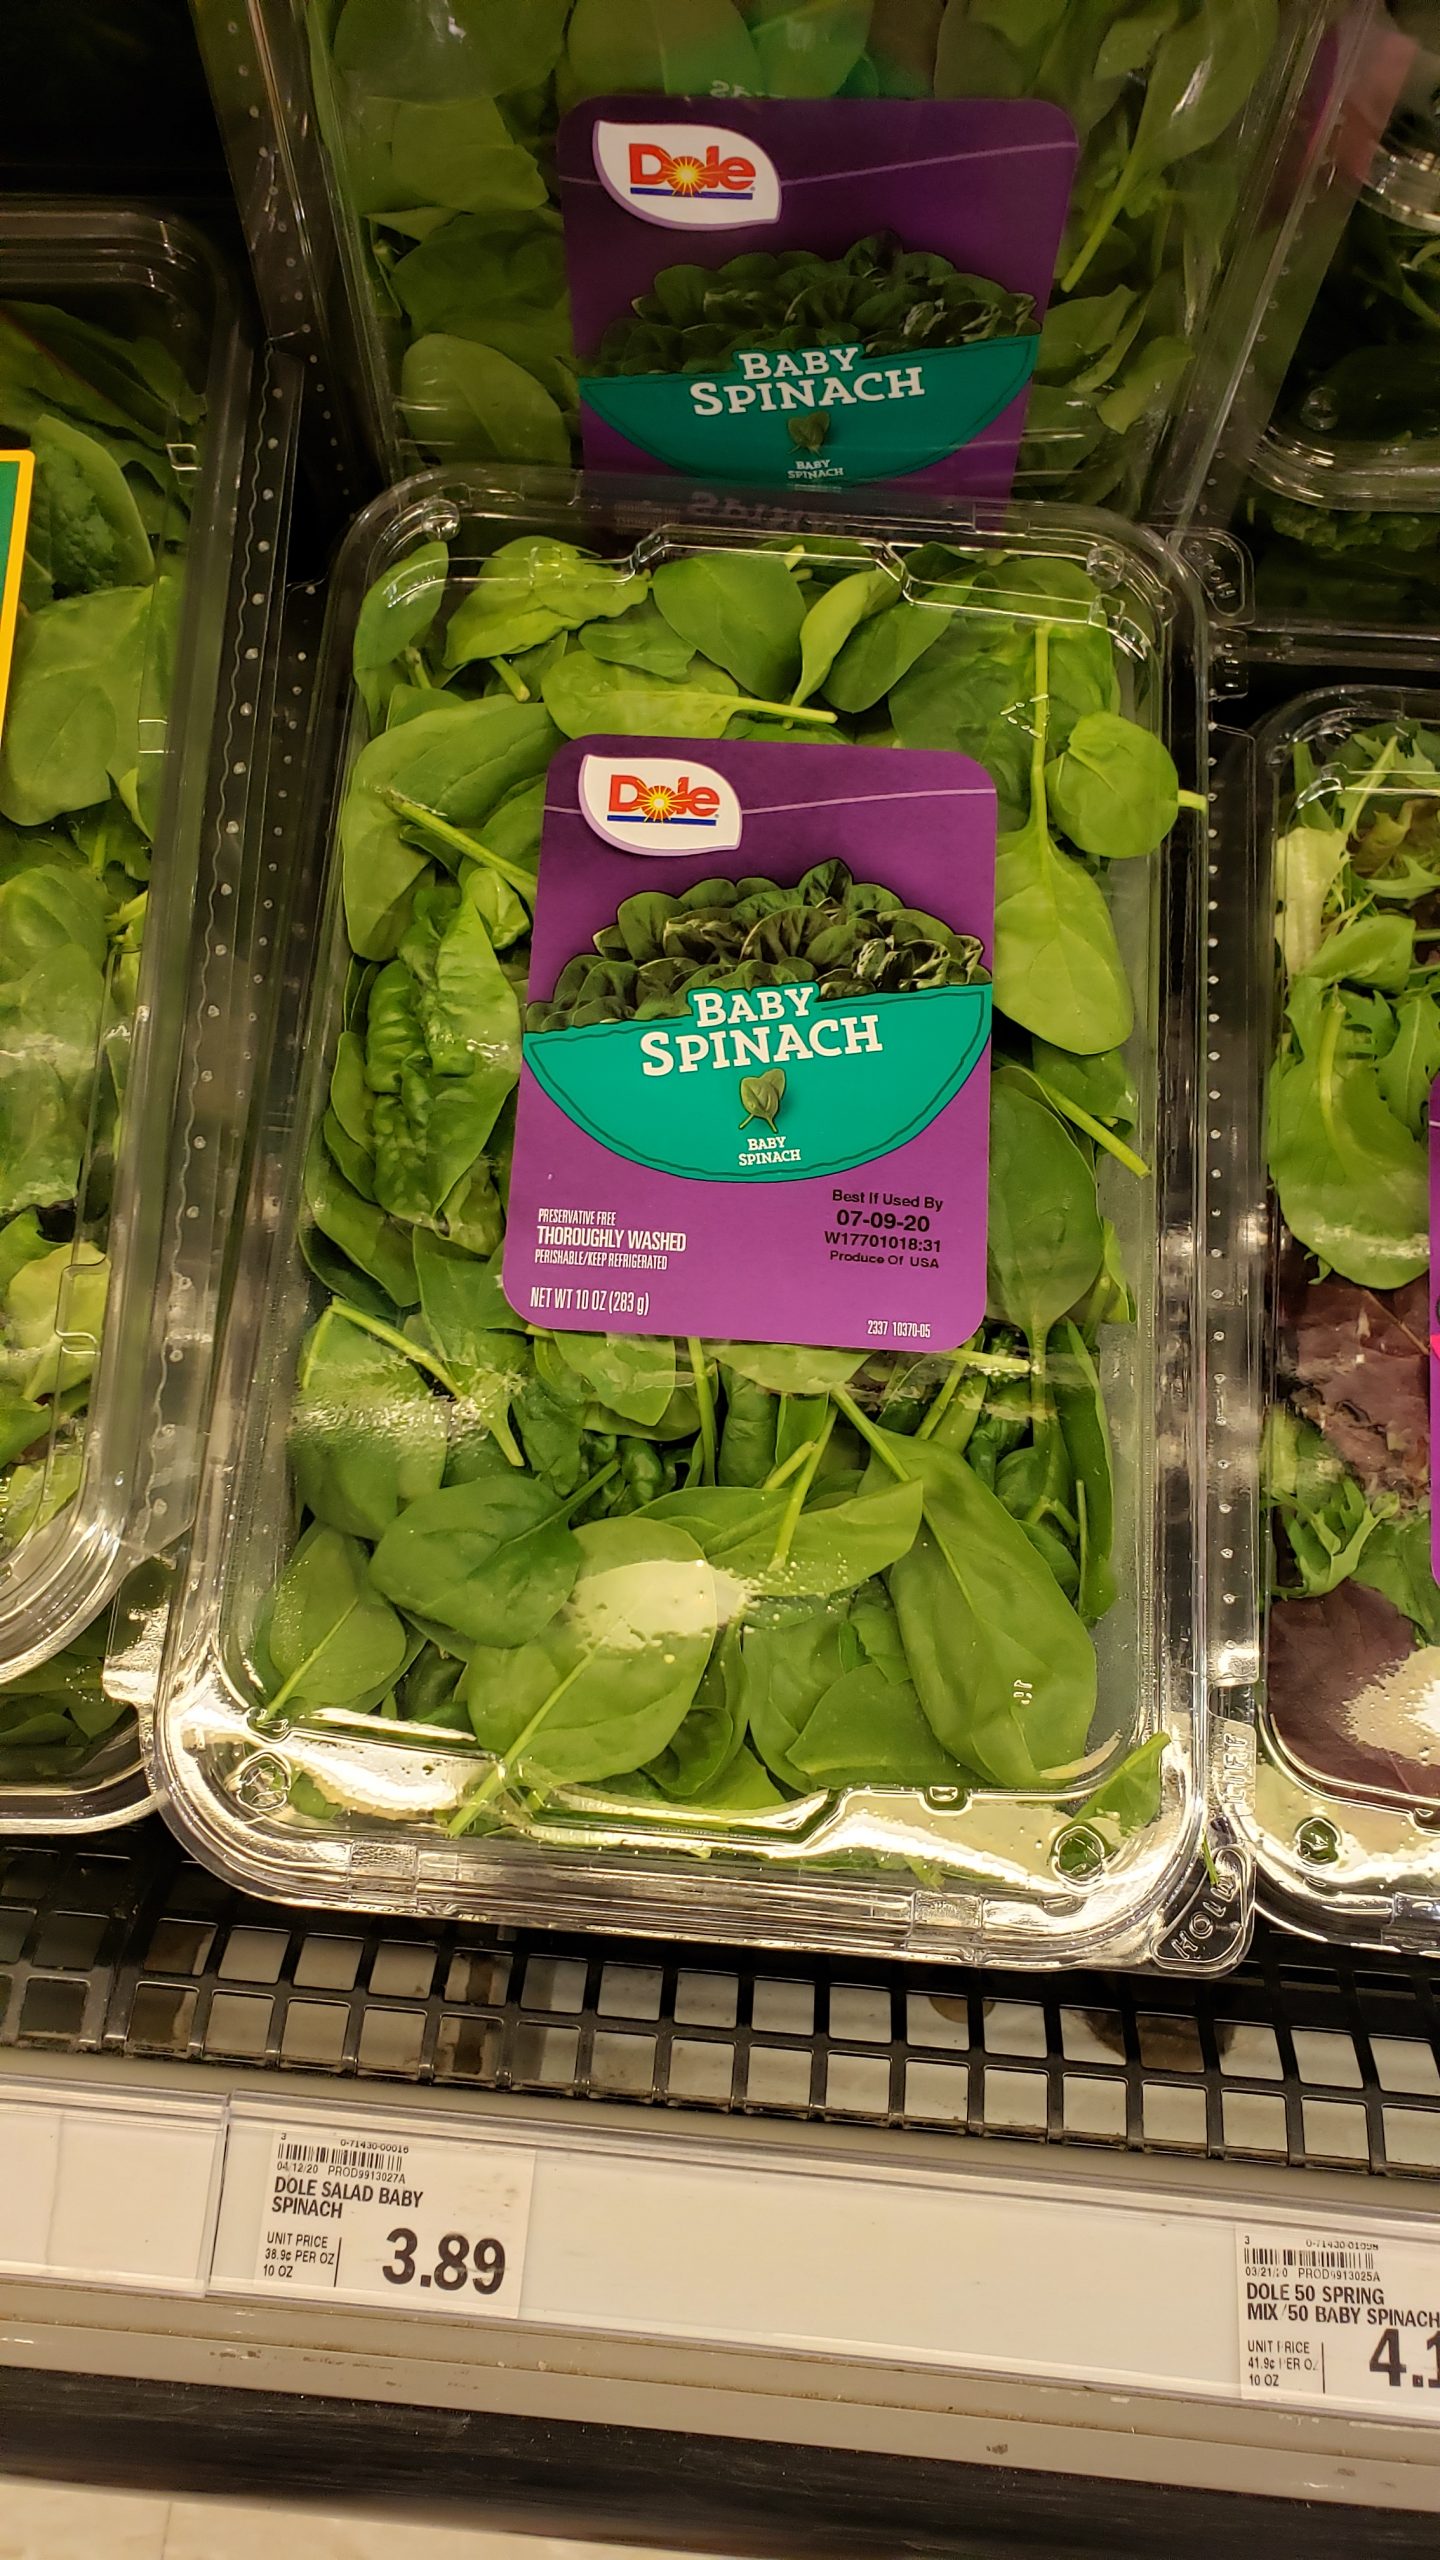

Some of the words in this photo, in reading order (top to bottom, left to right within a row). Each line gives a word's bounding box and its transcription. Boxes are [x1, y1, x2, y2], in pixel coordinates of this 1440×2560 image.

[629, 143, 756, 192] Dole
[740, 346, 861, 380] BABY
[689, 366, 926, 416] SPINACH
[787, 466, 844, 480] SPINACH
[795, 459, 832, 472] BABY
[608, 774, 720, 819] Dole
[693, 986, 815, 1029] BABY
[640, 1015, 884, 1077] SPINACH
[747, 1136, 787, 1151] BABY
[738, 1149, 801, 1166] SPINACH
[832, 1189, 865, 1203] Best
[869, 1192, 879, 1205] If
[883, 1193, 920, 1208] Used
[924, 1196, 943, 1212] By
[538, 1208, 595, 1225] PRESERVATIVE
[596, 1211, 616, 1227] FREE
[836, 1209, 930, 1232] 07-09-20
[537, 1225, 625, 1248] THOROUGHLY
[627, 1230, 687, 1252] WASHED
[535, 1249, 608, 1267] PERISHABLE/KEEP
[608, 1253, 668, 1270] REFRIGERATED
[830, 1250, 885, 1264] Produce
[888, 1254, 903, 1265] Of
[910, 1256, 939, 1268] USA
[530, 1287, 552, 1307] NET
[554, 1288, 574, 1309] WT
[576, 1289, 589, 1310] 10
[591, 1290, 607, 1311] OZ
[608, 1291, 635, 1314] (283
[637, 1292, 650, 1316] g)
[867, 1319, 888, 1336] 2337
[892, 1321, 931, 1338] 10370-05
[274, 2176, 318, 2196] DOLE
[321, 2181, 373, 2202] SALAD
[379, 2187, 424, 2208] BABY
[271, 2196, 343, 2219] SPINACH
[267, 2231, 293, 2245] UNIT
[295, 2234, 328, 2249] PRICE
[295, 2250, 316, 2263] PER
[319, 2252, 335, 2265] OZ
[382, 2227, 506, 2295] 3.89
[263, 2264, 274, 2277] 10
[278, 2265, 293, 2278] OZ
[1246, 2282, 1290, 2301] DOLE
[1295, 2285, 1315, 2302] 50
[1322, 2286, 1385, 2305] SPRING
[1316, 2306, 1361, 2324] BABY
[1367, 2308, 1440, 2328] SPINACH
[1247, 2339, 1273, 2353] UNIT
[1249, 2373, 1261, 2386] 10
[1264, 2374, 1279, 2387] OZ
